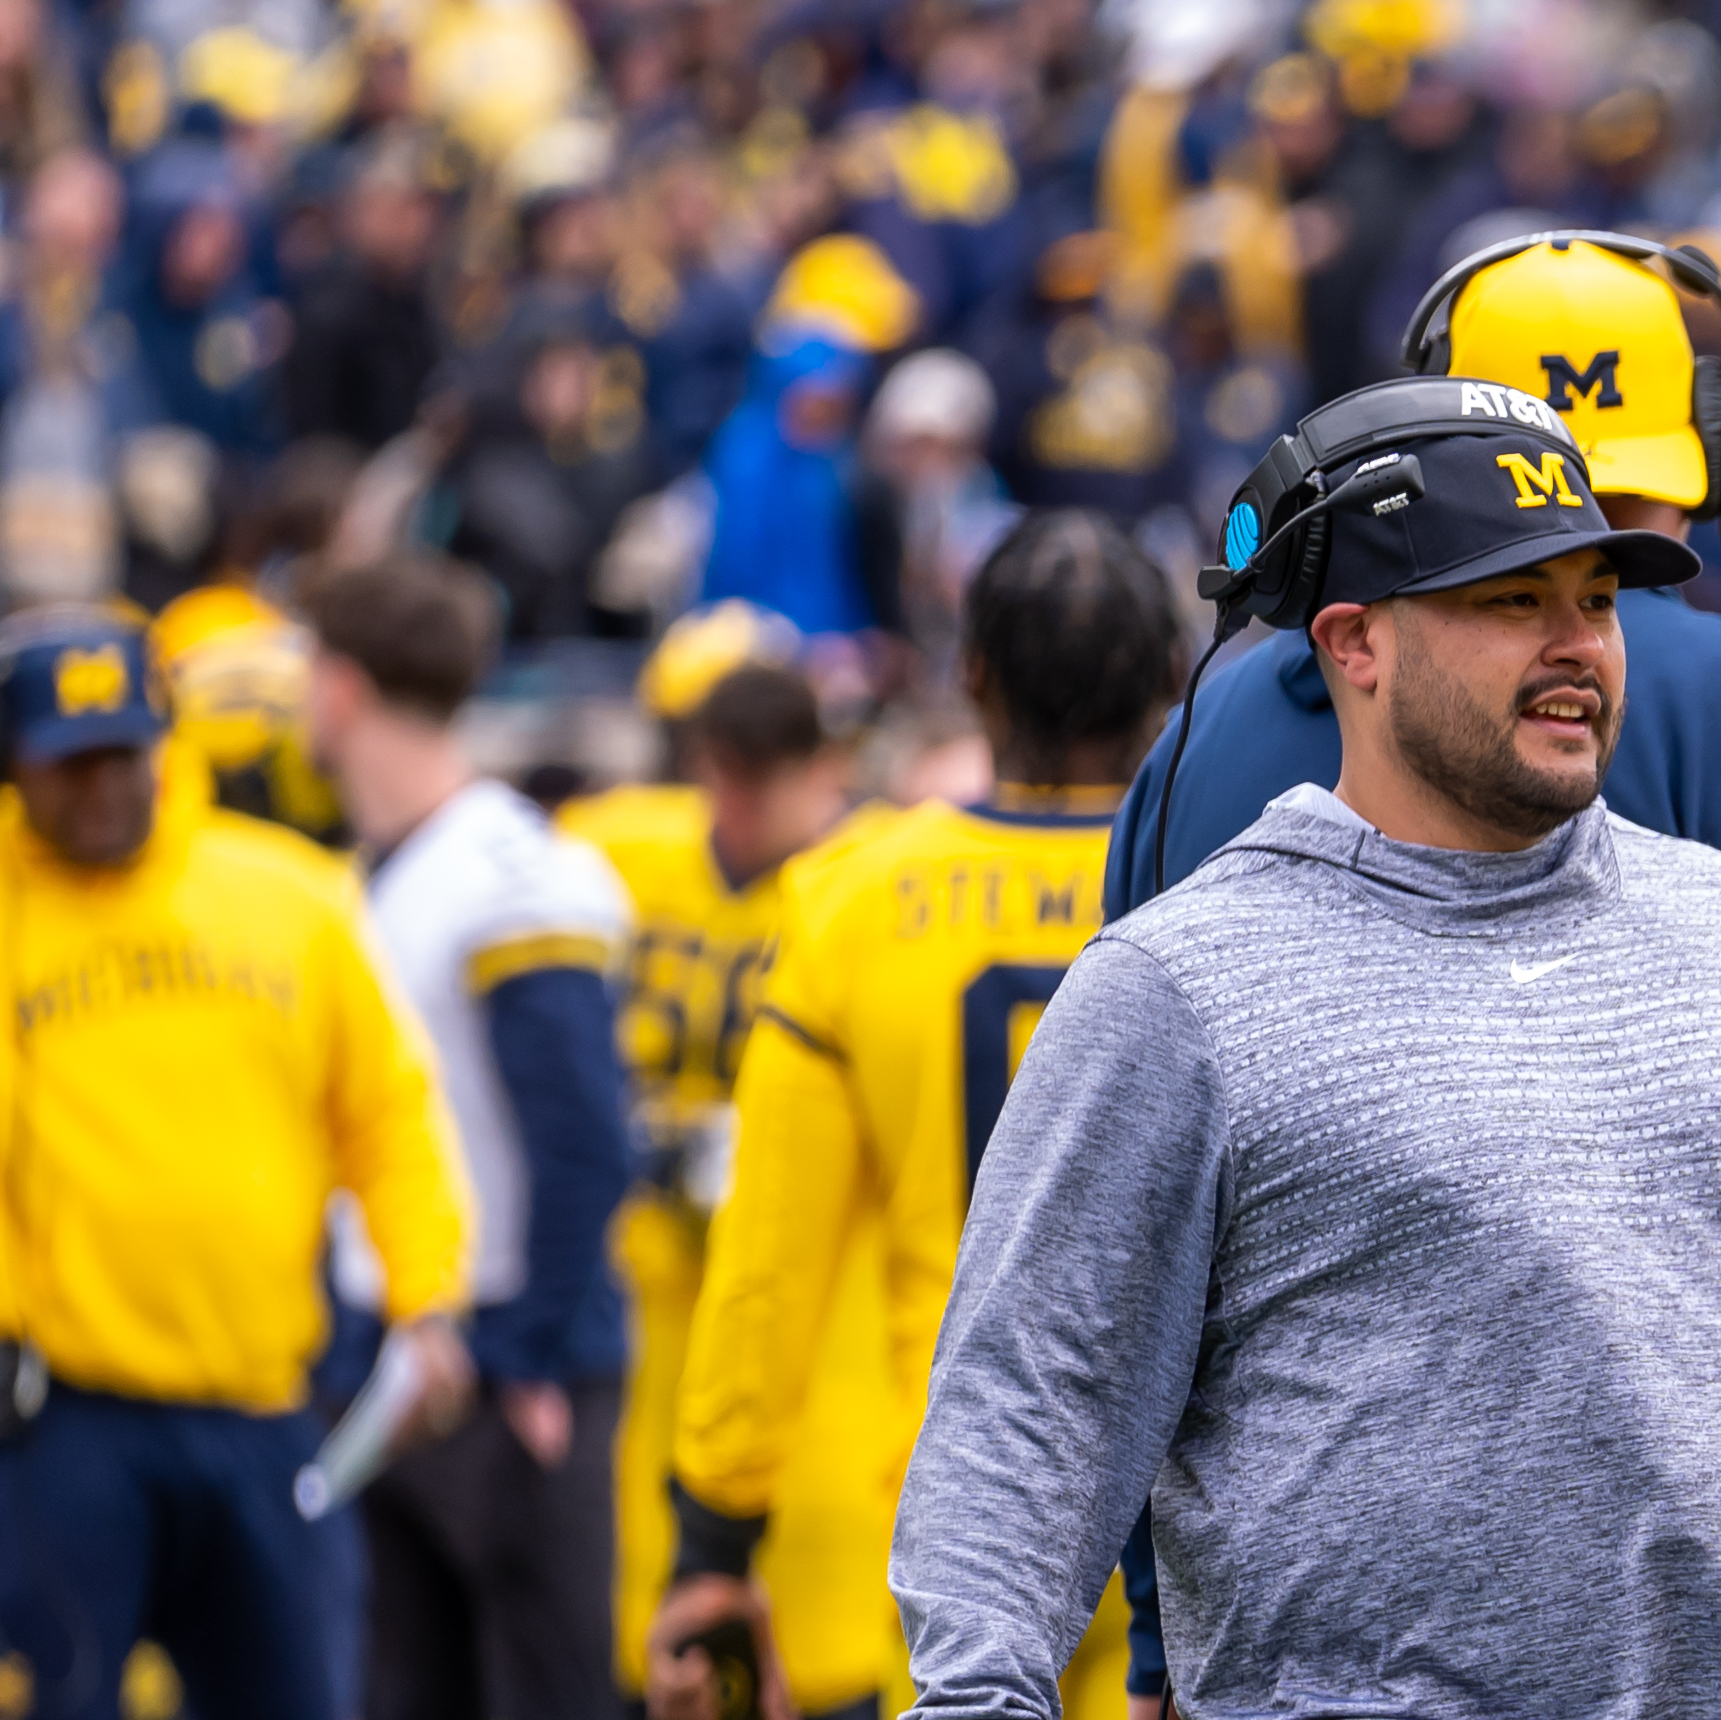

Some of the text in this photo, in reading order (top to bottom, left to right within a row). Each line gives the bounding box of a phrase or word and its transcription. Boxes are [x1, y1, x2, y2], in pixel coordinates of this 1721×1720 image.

[1460, 381, 1553, 431] AT&T
[1540, 349, 1624, 412] M
[1496, 452, 1583, 508] M
